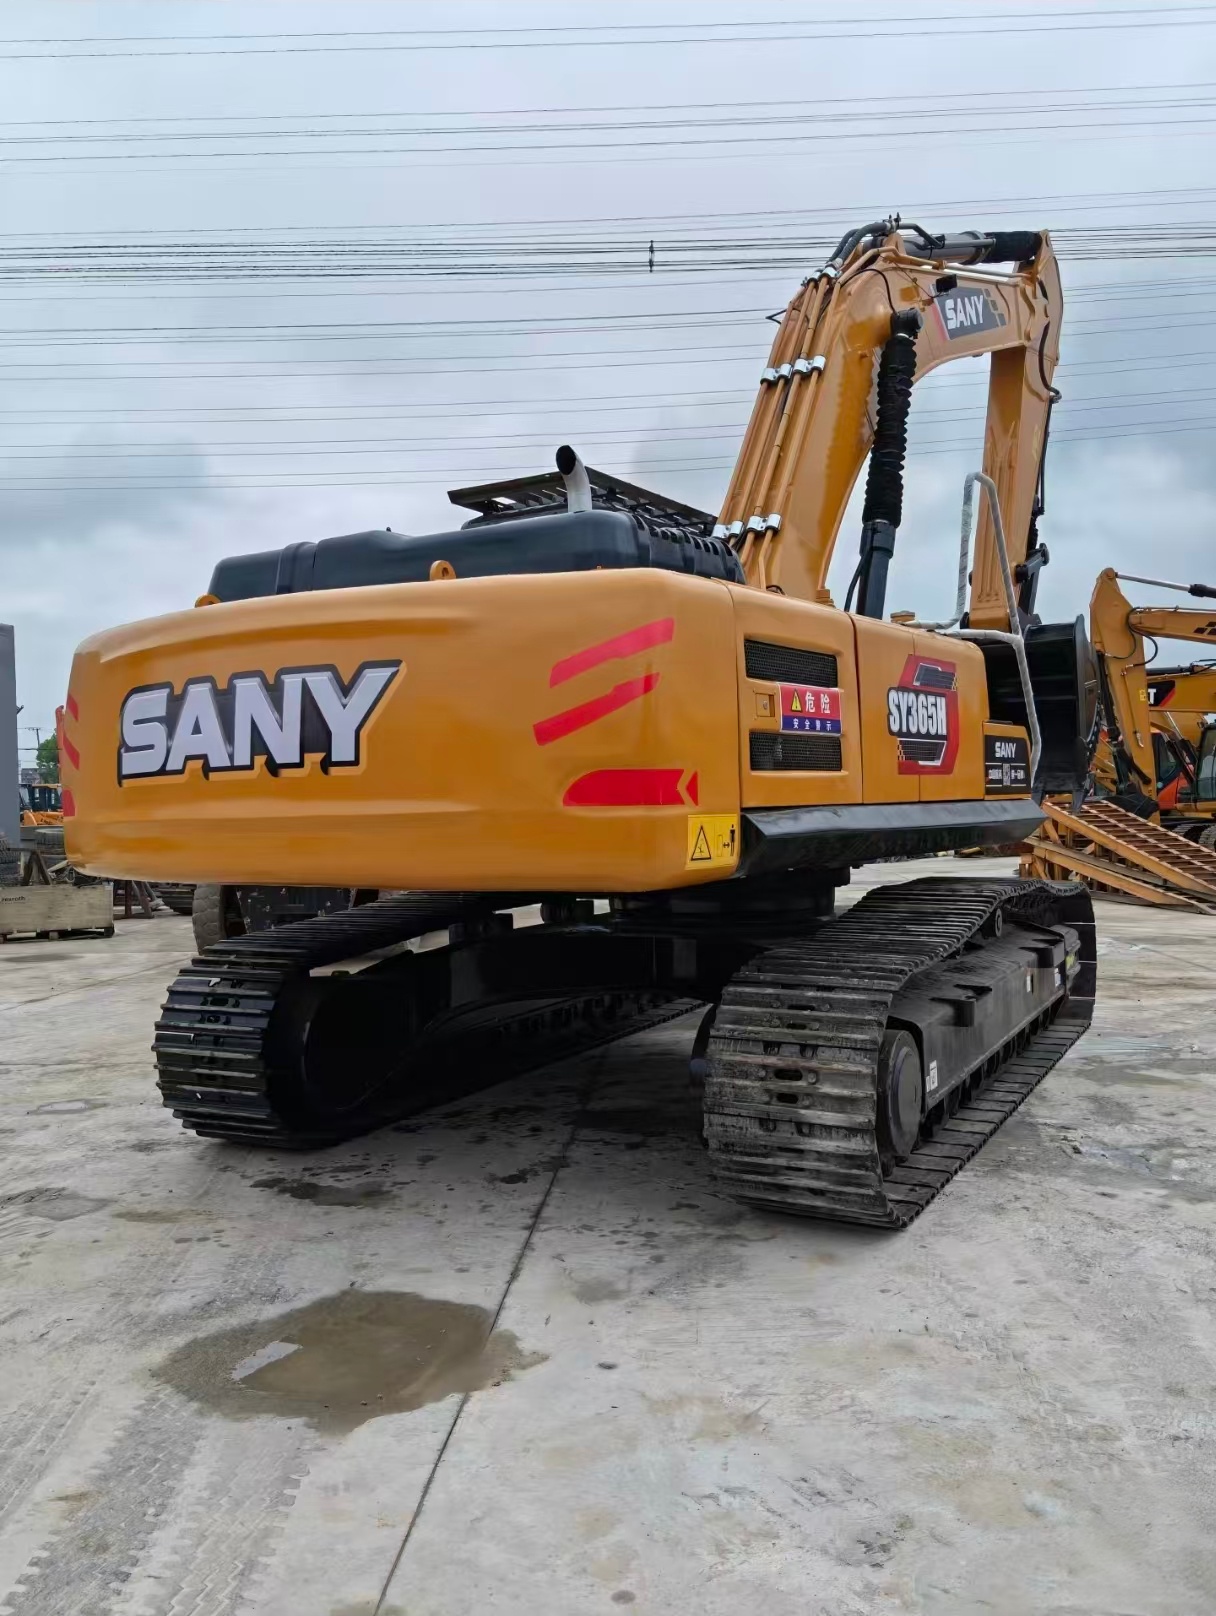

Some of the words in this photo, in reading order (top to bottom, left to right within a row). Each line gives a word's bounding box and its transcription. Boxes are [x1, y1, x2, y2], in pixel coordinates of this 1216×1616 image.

[945, 295, 984, 330] SANY
[120, 663, 400, 777] SANY
[805, 691, 831, 714] 危险
[888, 689, 948, 736] SY365H
[995, 741, 1017, 758] SANY
